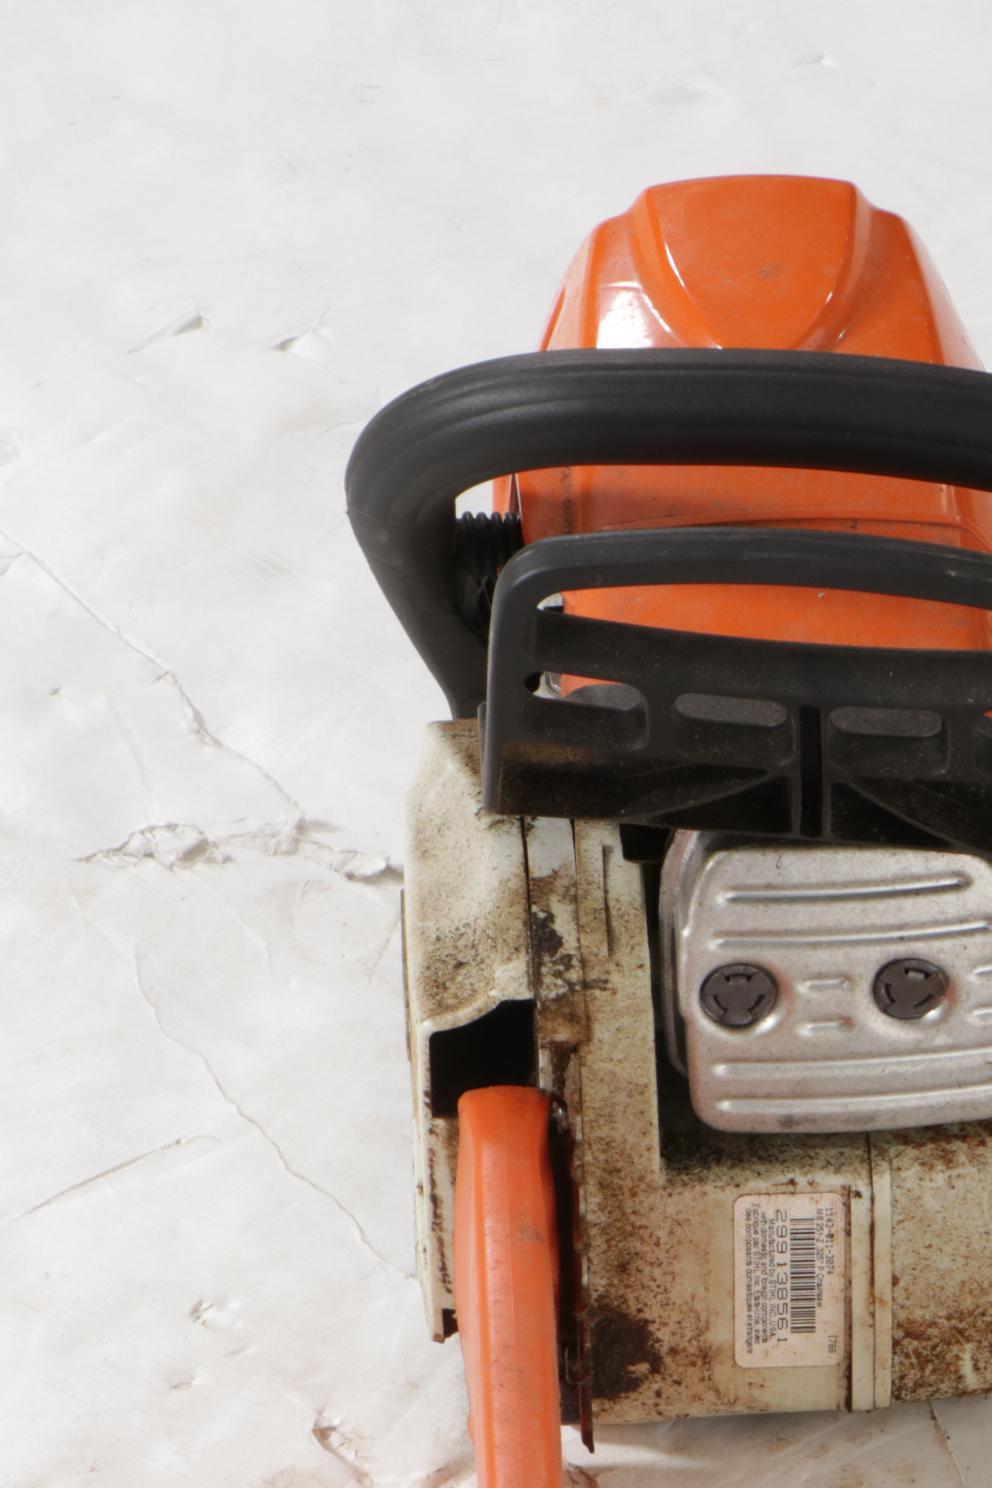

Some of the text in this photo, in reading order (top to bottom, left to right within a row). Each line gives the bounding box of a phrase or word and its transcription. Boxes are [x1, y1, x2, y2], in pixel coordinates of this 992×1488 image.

[744, 1224, 752, 1266] composants
[768, 1218, 776, 1267] Manufactured
[760, 1277, 768, 1300] foreign
[767, 1269, 776, 1278] by
[768, 1280, 777, 1302] STIHL
[776, 1209, 788, 1343] 299138561
[816, 1273, 824, 1308] Chainsaw
[760, 1302, 768, 1343] components
